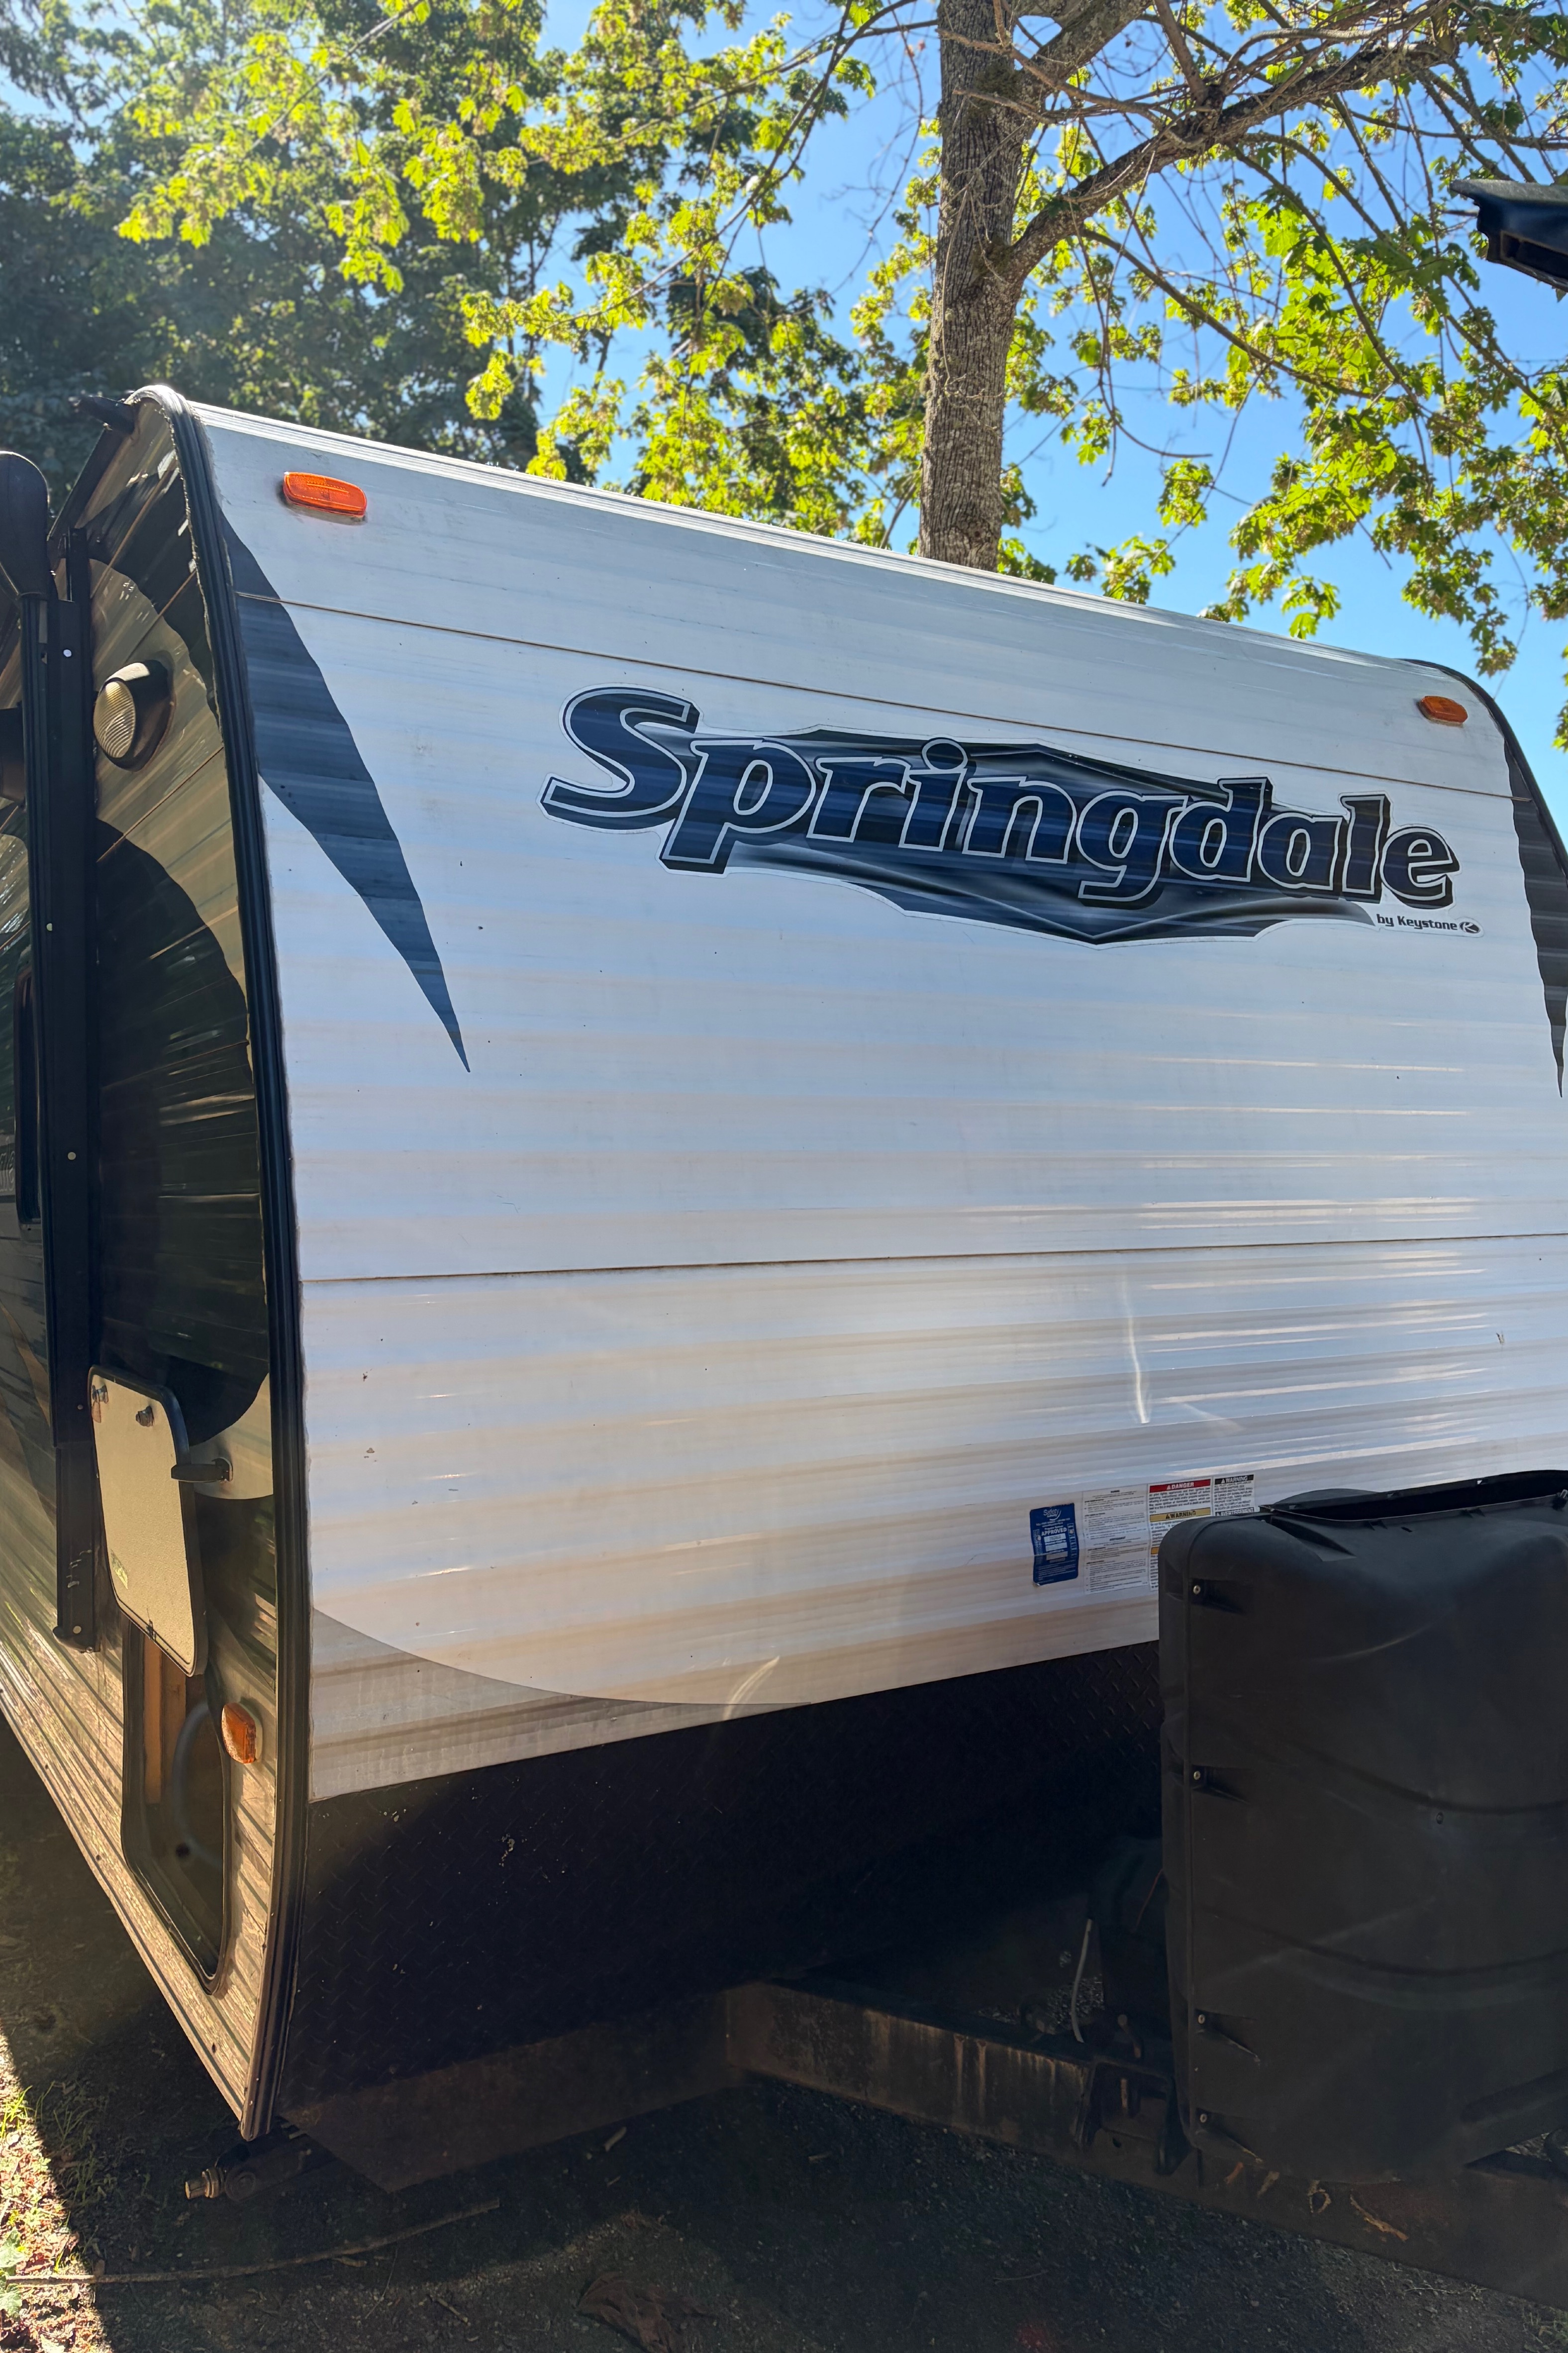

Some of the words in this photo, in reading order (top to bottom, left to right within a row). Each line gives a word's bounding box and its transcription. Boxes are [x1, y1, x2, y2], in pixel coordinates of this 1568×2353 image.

[540, 685, 1459, 909] Springdale
[1376, 914, 1394, 926] by
[1397, 916, 1458, 930] Keystone
[1042, 1528, 1067, 1536] APPROVED
